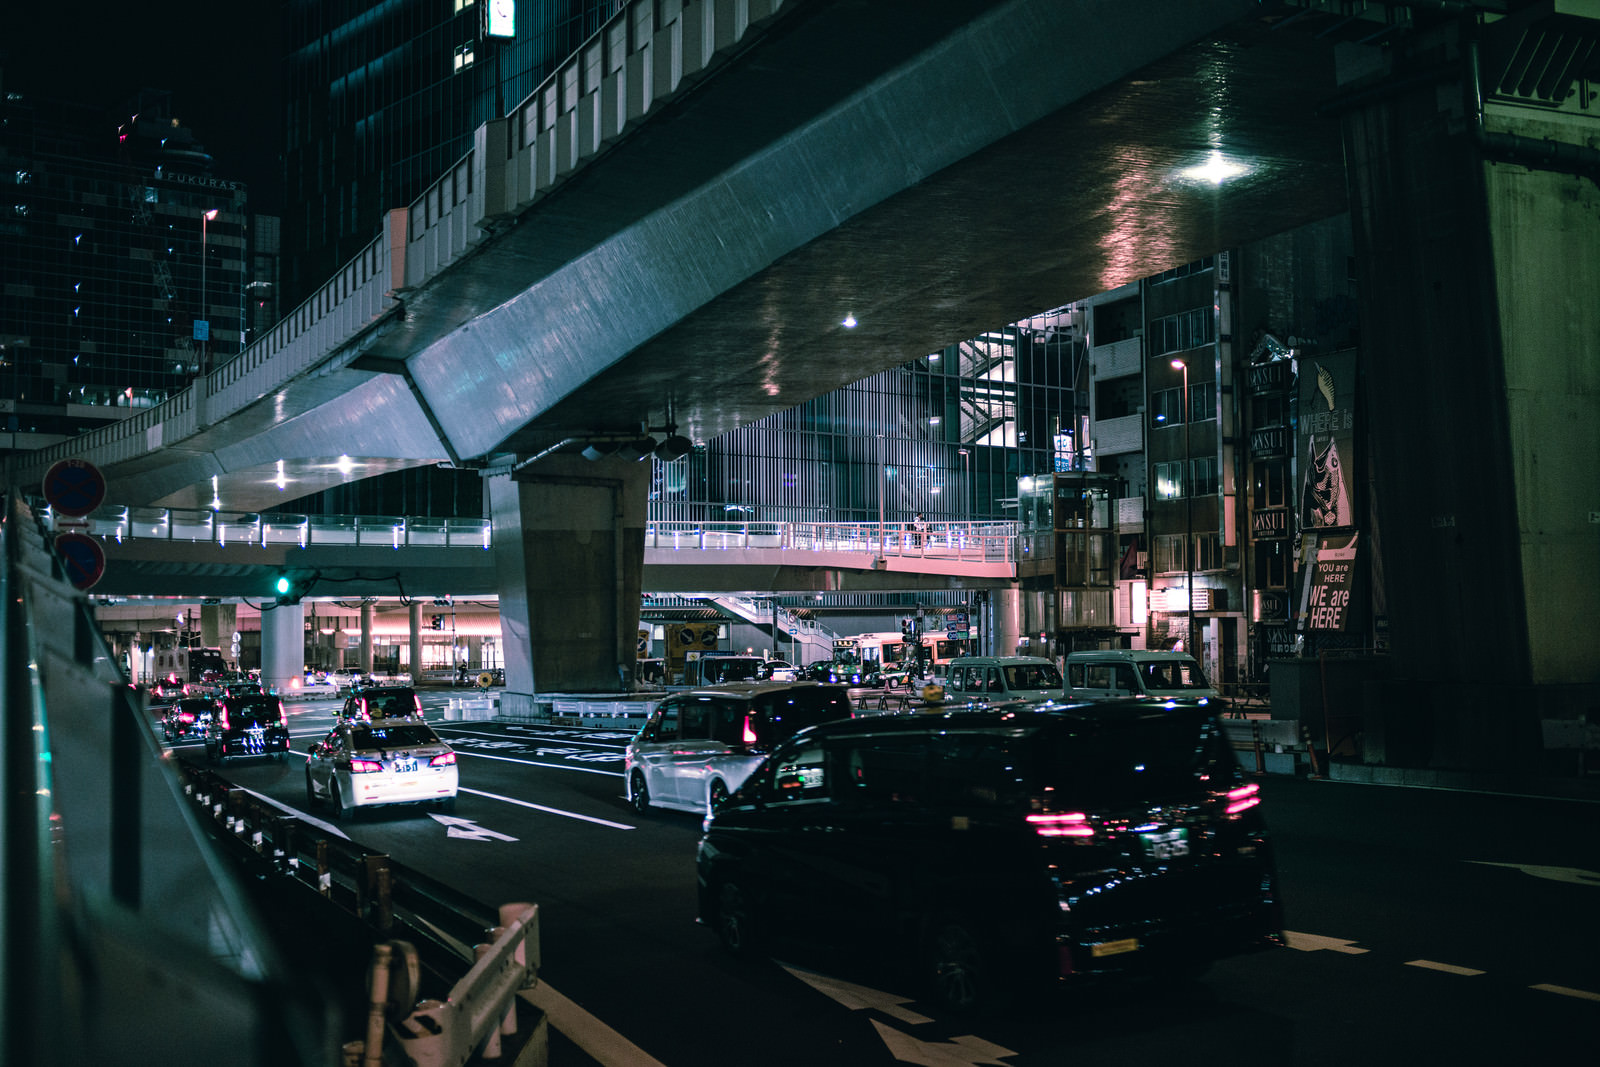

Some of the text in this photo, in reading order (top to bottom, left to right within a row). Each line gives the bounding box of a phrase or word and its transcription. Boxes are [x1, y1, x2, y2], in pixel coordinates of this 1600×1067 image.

[167, 172, 237, 190] FUKURAS
[1301, 411, 1339, 434] WHERE
[1318, 563, 1349, 573] YOU are
[1323, 574, 1346, 583] HERE
[1309, 585, 1350, 607] WE are
[1309, 607, 1342, 629] HERE
